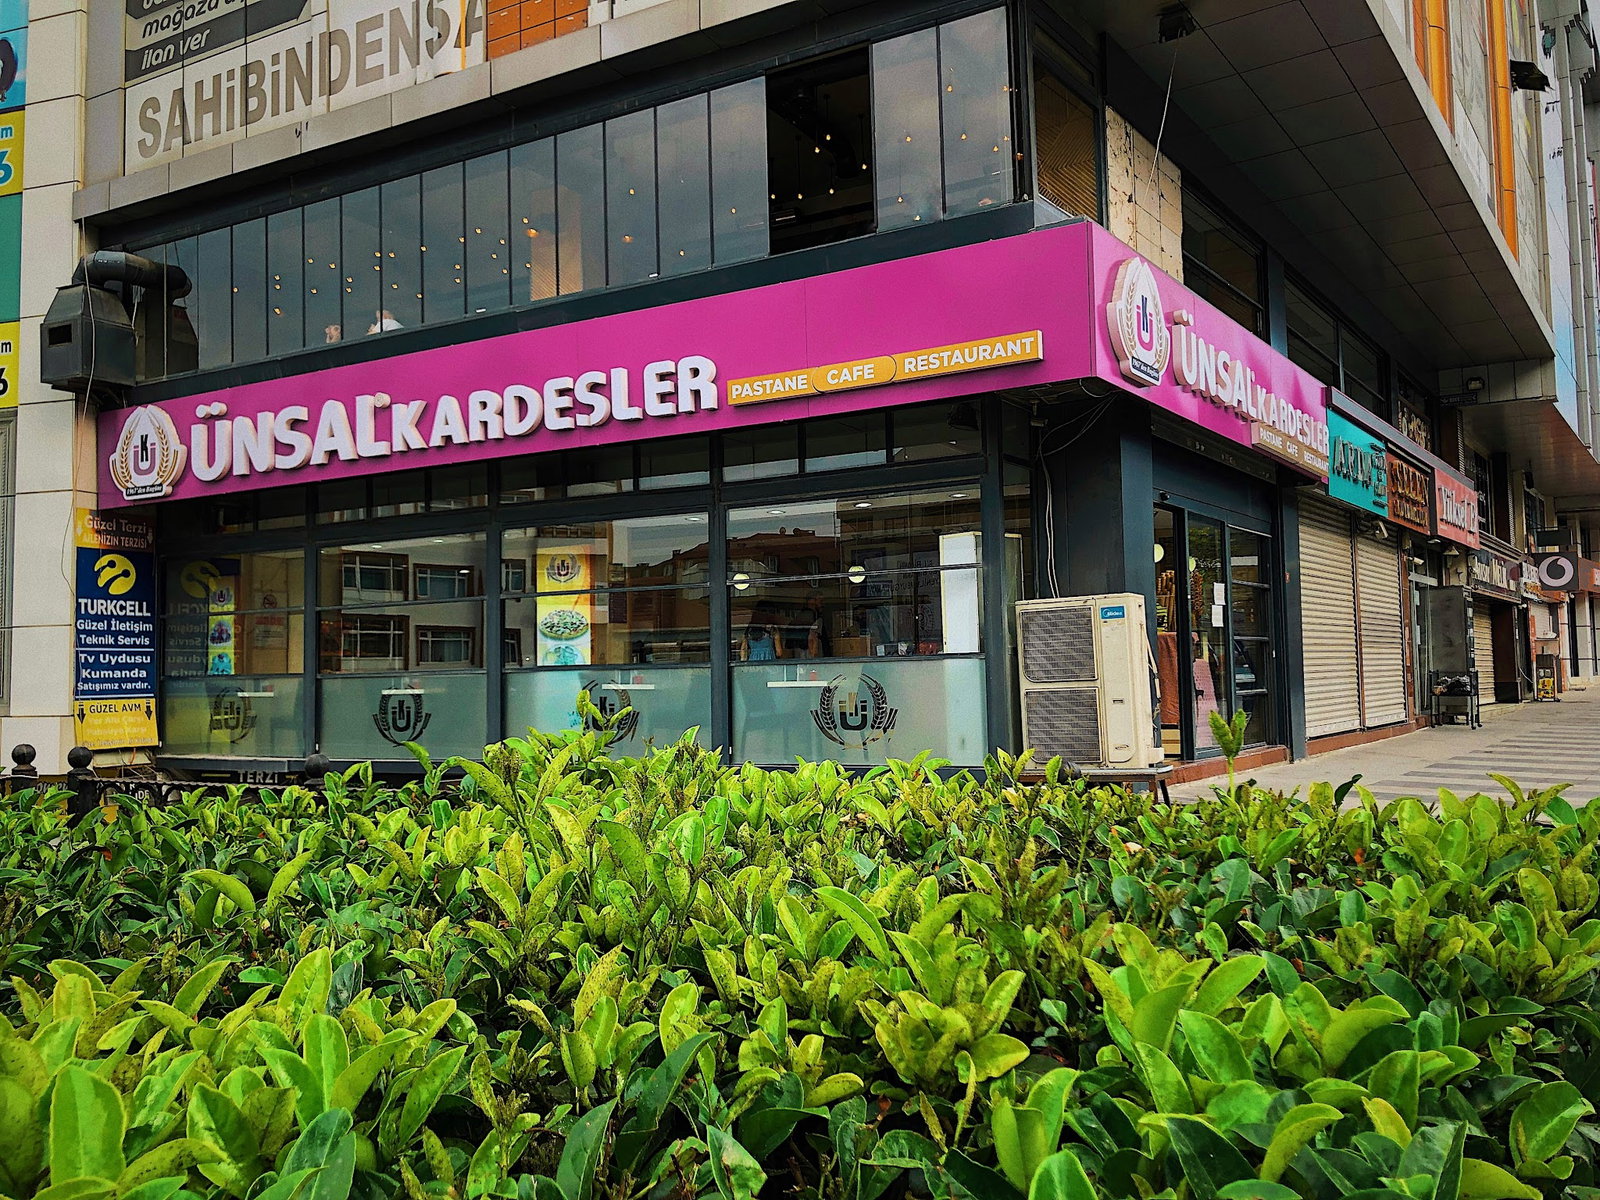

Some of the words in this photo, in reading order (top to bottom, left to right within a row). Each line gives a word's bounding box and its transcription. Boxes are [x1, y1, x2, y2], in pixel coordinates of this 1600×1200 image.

[179, 28, 211, 56] ver
[731, 374, 808, 399] PASTANE
[826, 363, 876, 386] CAFE
[903, 336, 1036, 373] RESTAURANT
[1286, 441, 1299, 457] CAFE
[84, 514, 116, 531] Güzel
[120, 519, 146, 534] Terzi
[78, 598, 152, 617] TURKCELL
[76, 618, 108, 631] Güzel
[110, 618, 153, 633] İletişim
[79, 634, 115, 645] Teknik
[117, 635, 150, 645] Servis
[79, 653, 95, 663] Tv
[99, 653, 151, 665] Uydusu
[82, 668, 147, 679] Kumanda
[89, 702, 119, 714] GÜZEL
[121, 703, 142, 712] AVM
